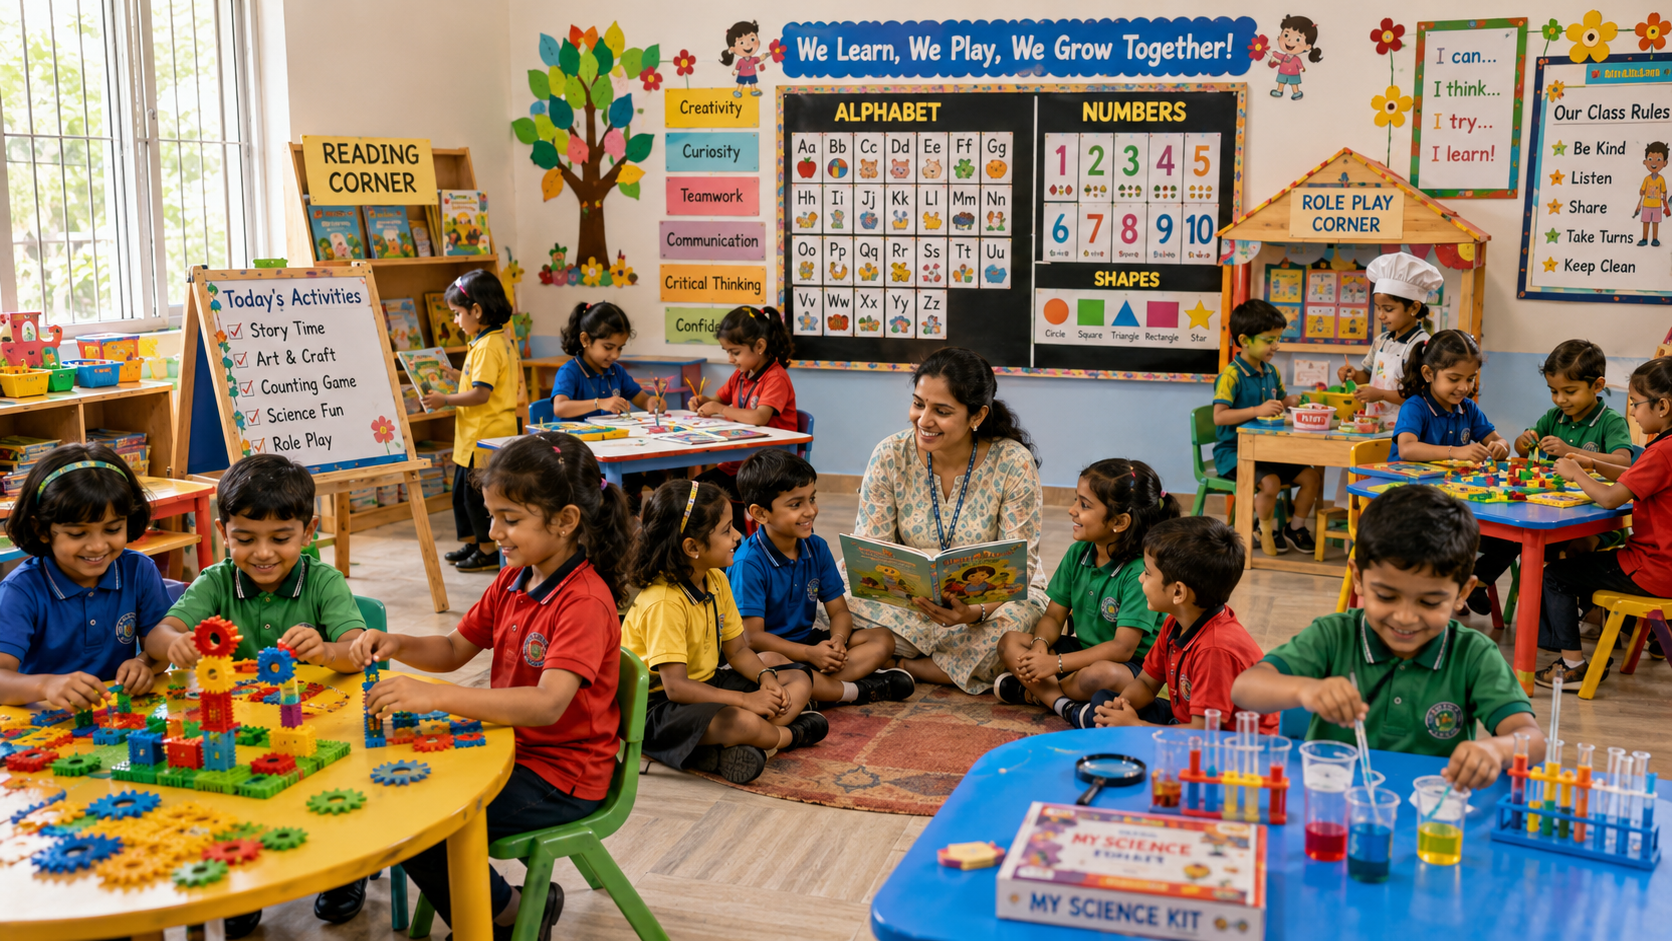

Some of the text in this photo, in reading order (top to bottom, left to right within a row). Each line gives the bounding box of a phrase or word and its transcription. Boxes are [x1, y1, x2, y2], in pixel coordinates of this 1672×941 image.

[797, 33, 1233, 68] We Learn, We Play, We Grow Together!
[1436, 48, 1496, 64] I can...
[1434, 80, 1500, 97] I think...
[680, 100, 742, 118] Creativity
[834, 102, 941, 121] ALPHABET
[1083, 101, 1186, 122] NUMBERS
[1554, 103, 1670, 120] Our Class Rules
[1434, 113, 1492, 134] I try...
[323, 143, 419, 164] READING
[683, 144, 740, 163] Curiosity
[798, 138, 1006, 158] Aa Bb Cc Dd Ee Ff Gg
[1432, 145, 1495, 162] I learn!
[1574, 141, 1626, 155] Be Kind
[1056, 145, 1210, 177] 1 2 3 4 5
[329, 172, 416, 193] CORNER
[1572, 171, 1611, 184] Listen
[681, 188, 743, 202] Teamwork
[798, 190, 1005, 210] Hh Ii Jj Kk Ll Mm Nn
[1303, 195, 1393, 210] ROLE PLAY
[1569, 200, 1607, 214] Share
[1052, 214, 1213, 244] 6 7 8 9 10
[1313, 217, 1380, 232] CORNER
[667, 232, 758, 247] Communication
[1567, 230, 1633, 243] Take Turns
[798, 242, 1004, 261] Oo Pp Qq Rr Ss Tt Uu
[1565, 259, 1635, 276] Keep Clean
[665, 275, 761, 295] Critical Thinking
[1094, 271, 1160, 287] SHAPES
[223, 288, 361, 313] Today's Activities
[799, 293, 940, 314] Vv Ww Xx Yy Zz
[250, 321, 325, 341] Story Time
[676, 318, 721, 333] Confide
[1045, 329, 1065, 338] Circle
[1078, 330, 1102, 340] Square
[1112, 331, 1139, 342] Triangle
[1145, 332, 1179, 344] Rectangle
[1191, 333, 1207, 342] Star
[257, 347, 336, 366] Art & Craft
[261, 375, 356, 395] Counting Game
[267, 403, 344, 423] Science Fun
[273, 432, 331, 452] Role Play
[1072, 833, 1099, 845] MY
[1103, 836, 1192, 856] SCIENCE
[1030, 892, 1202, 930] MY SCIENCE KIT
